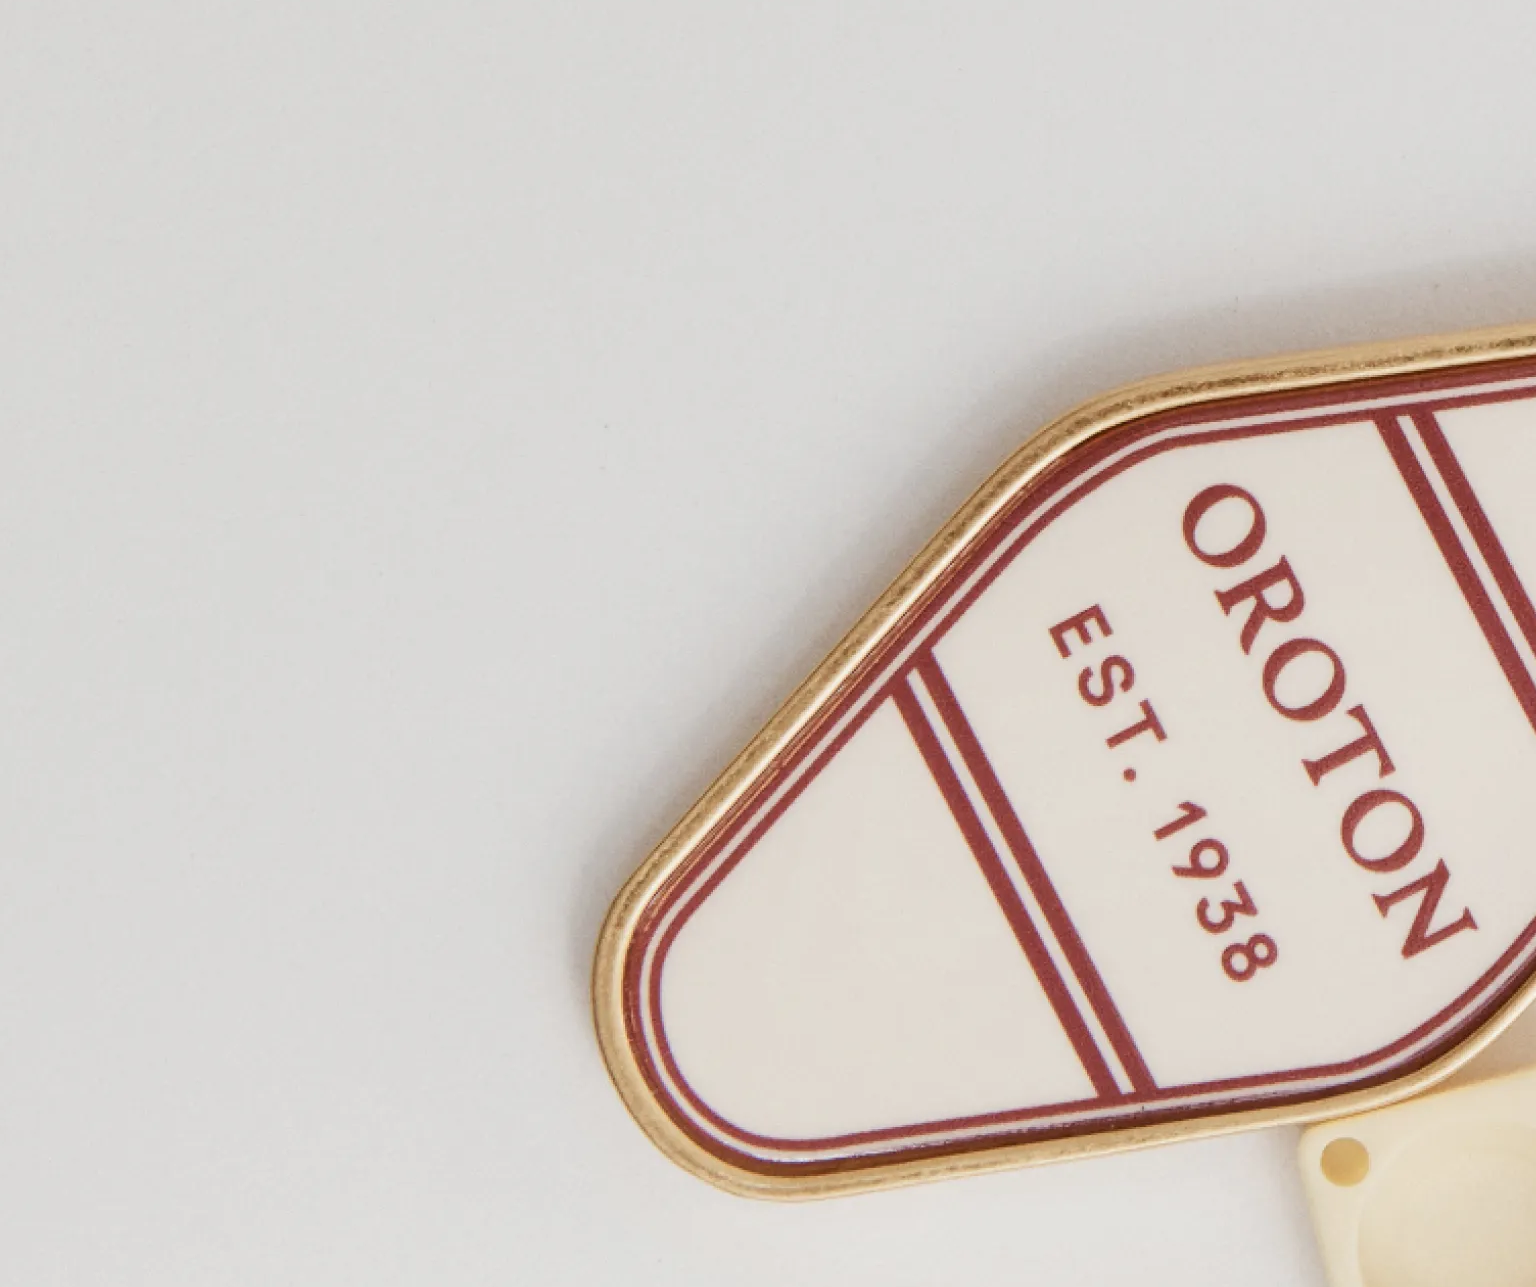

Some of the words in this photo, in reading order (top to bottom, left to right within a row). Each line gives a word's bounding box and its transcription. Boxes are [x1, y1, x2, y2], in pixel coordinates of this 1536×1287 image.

[1048, 604, 1167, 782] EST.
[1152, 801, 1278, 983] 1938
[1181, 483, 1478, 960] OROTON
